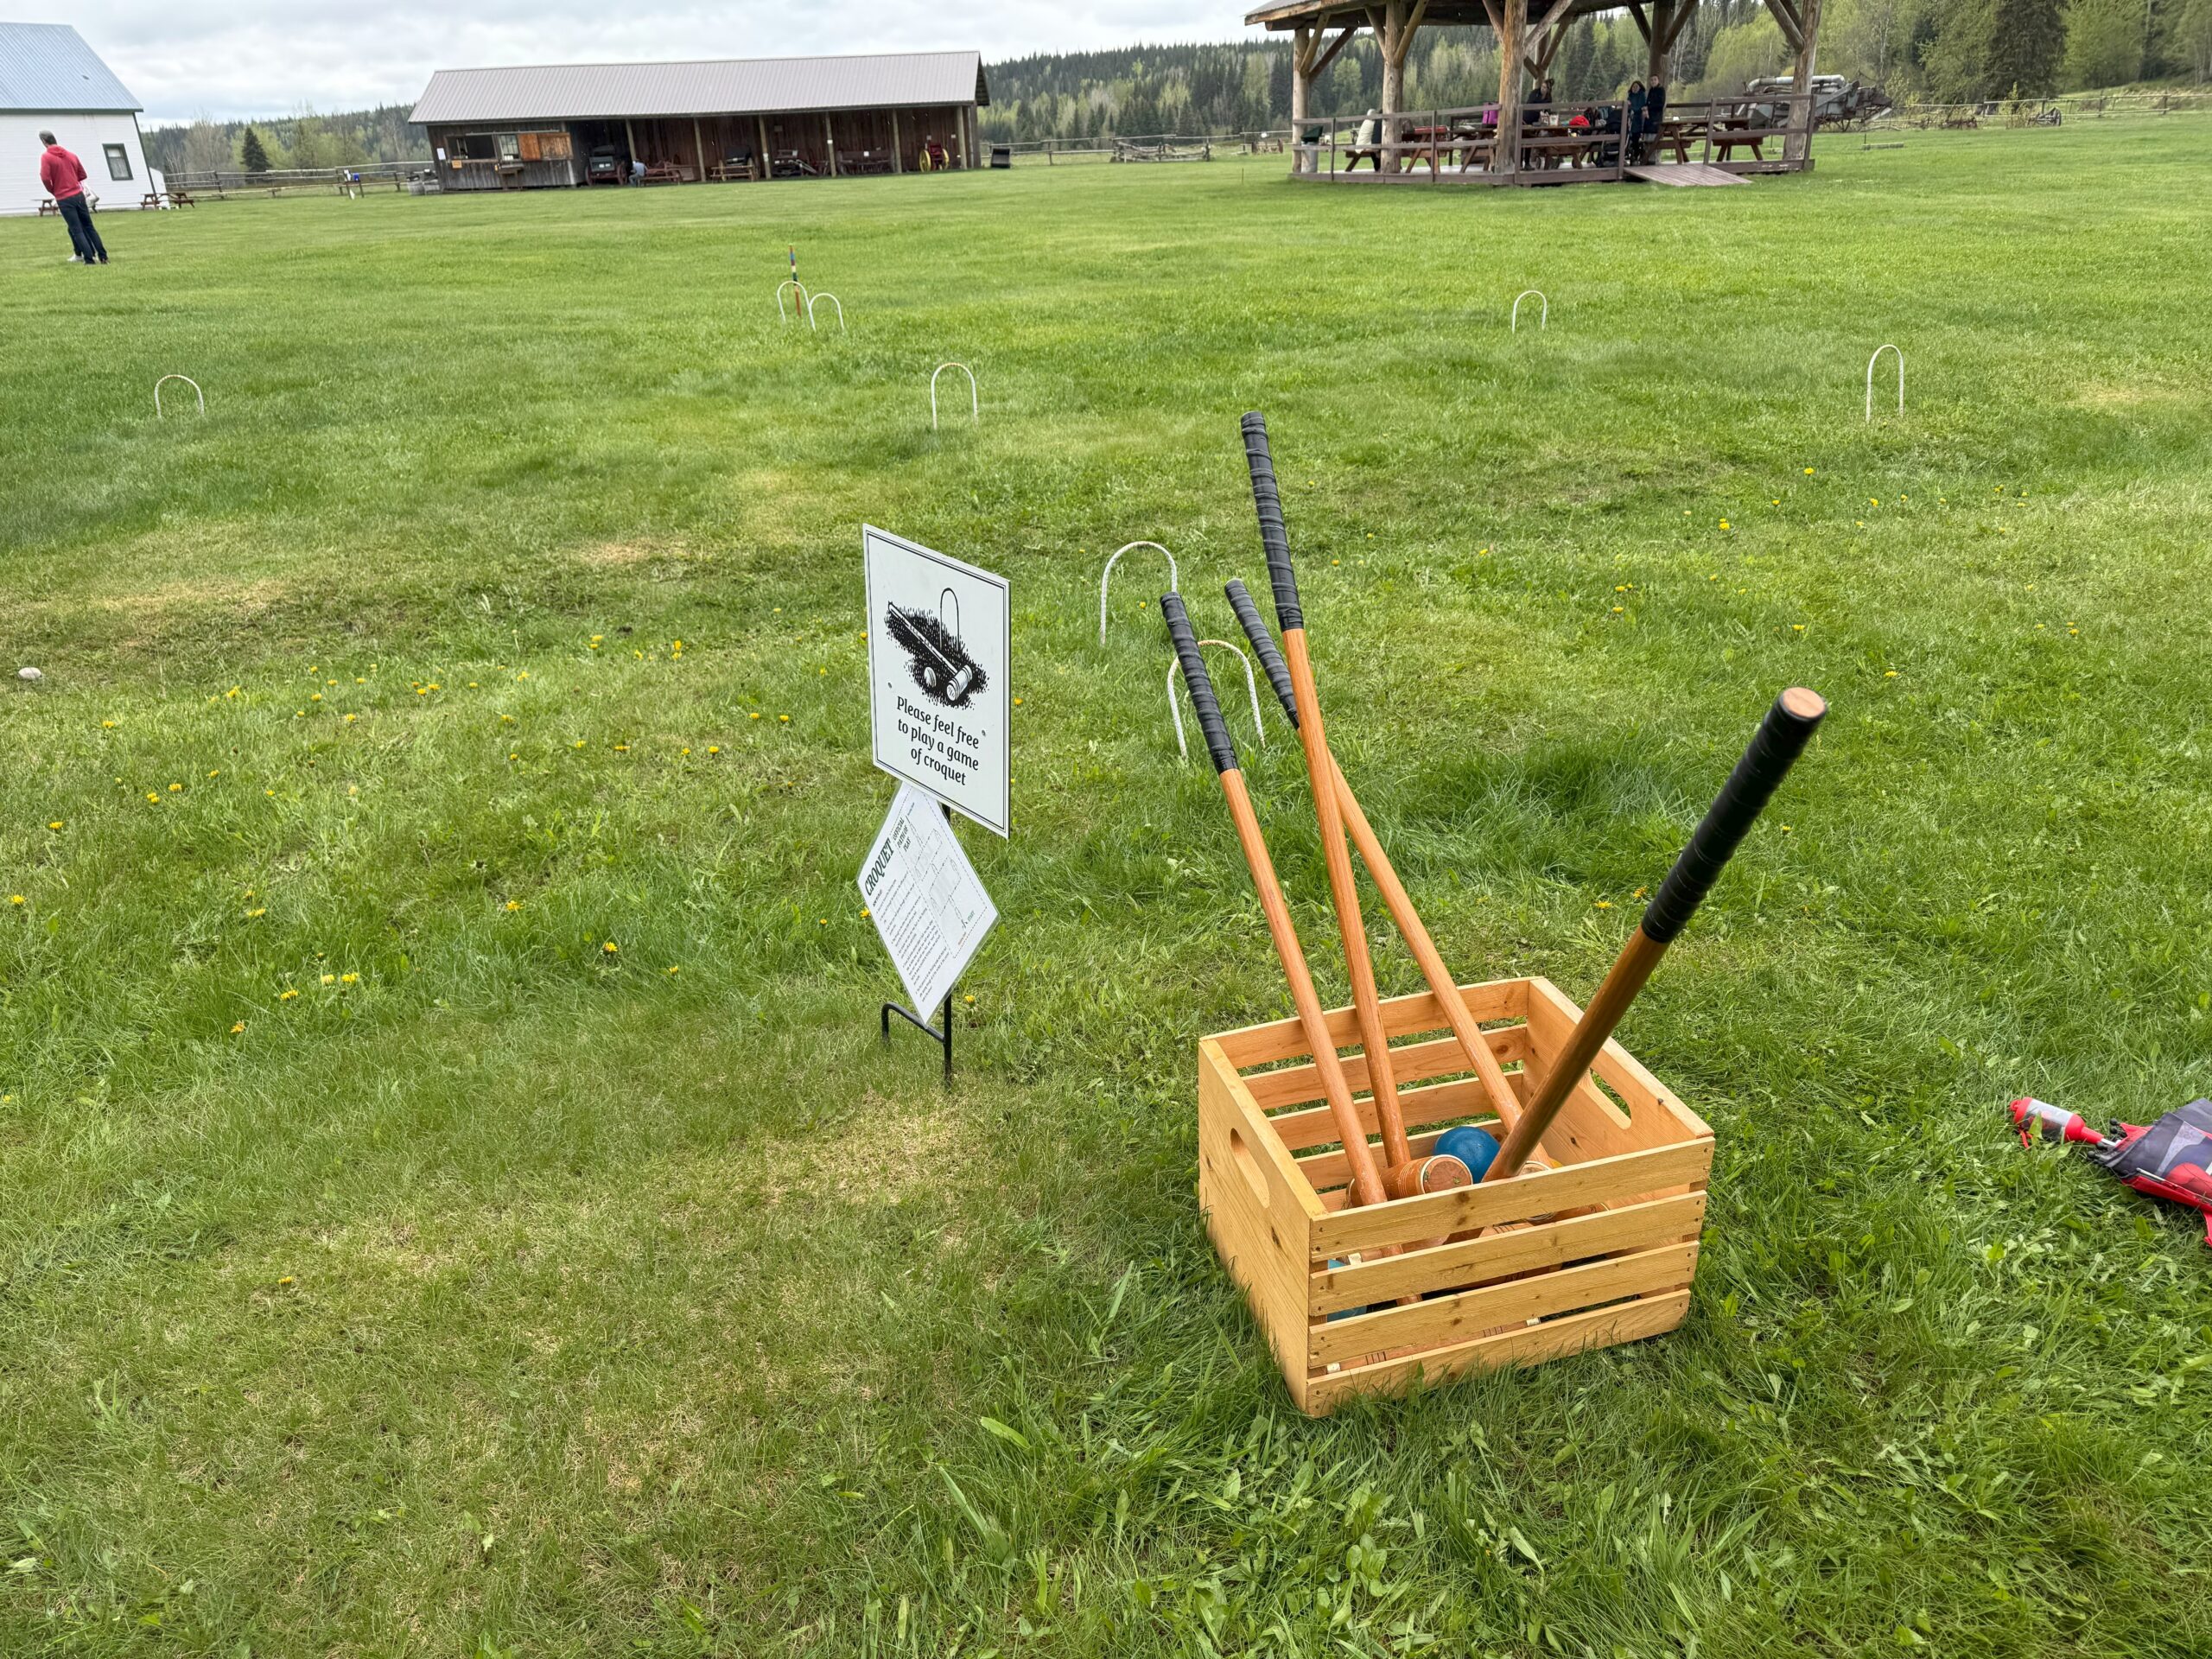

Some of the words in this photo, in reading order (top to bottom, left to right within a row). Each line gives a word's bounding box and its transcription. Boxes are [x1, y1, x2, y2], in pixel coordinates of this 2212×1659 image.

[896, 696, 931, 725] Please
[933, 715, 954, 737] feel
[956, 727, 979, 749] free
[898, 718, 908, 734] to
[911, 726, 935, 751] play
[937, 741, 944, 753] a
[947, 747, 979, 771] game
[911, 747, 922, 766] of
[924, 755, 966, 785] croquet
[865, 837, 894, 896] CROQUET
